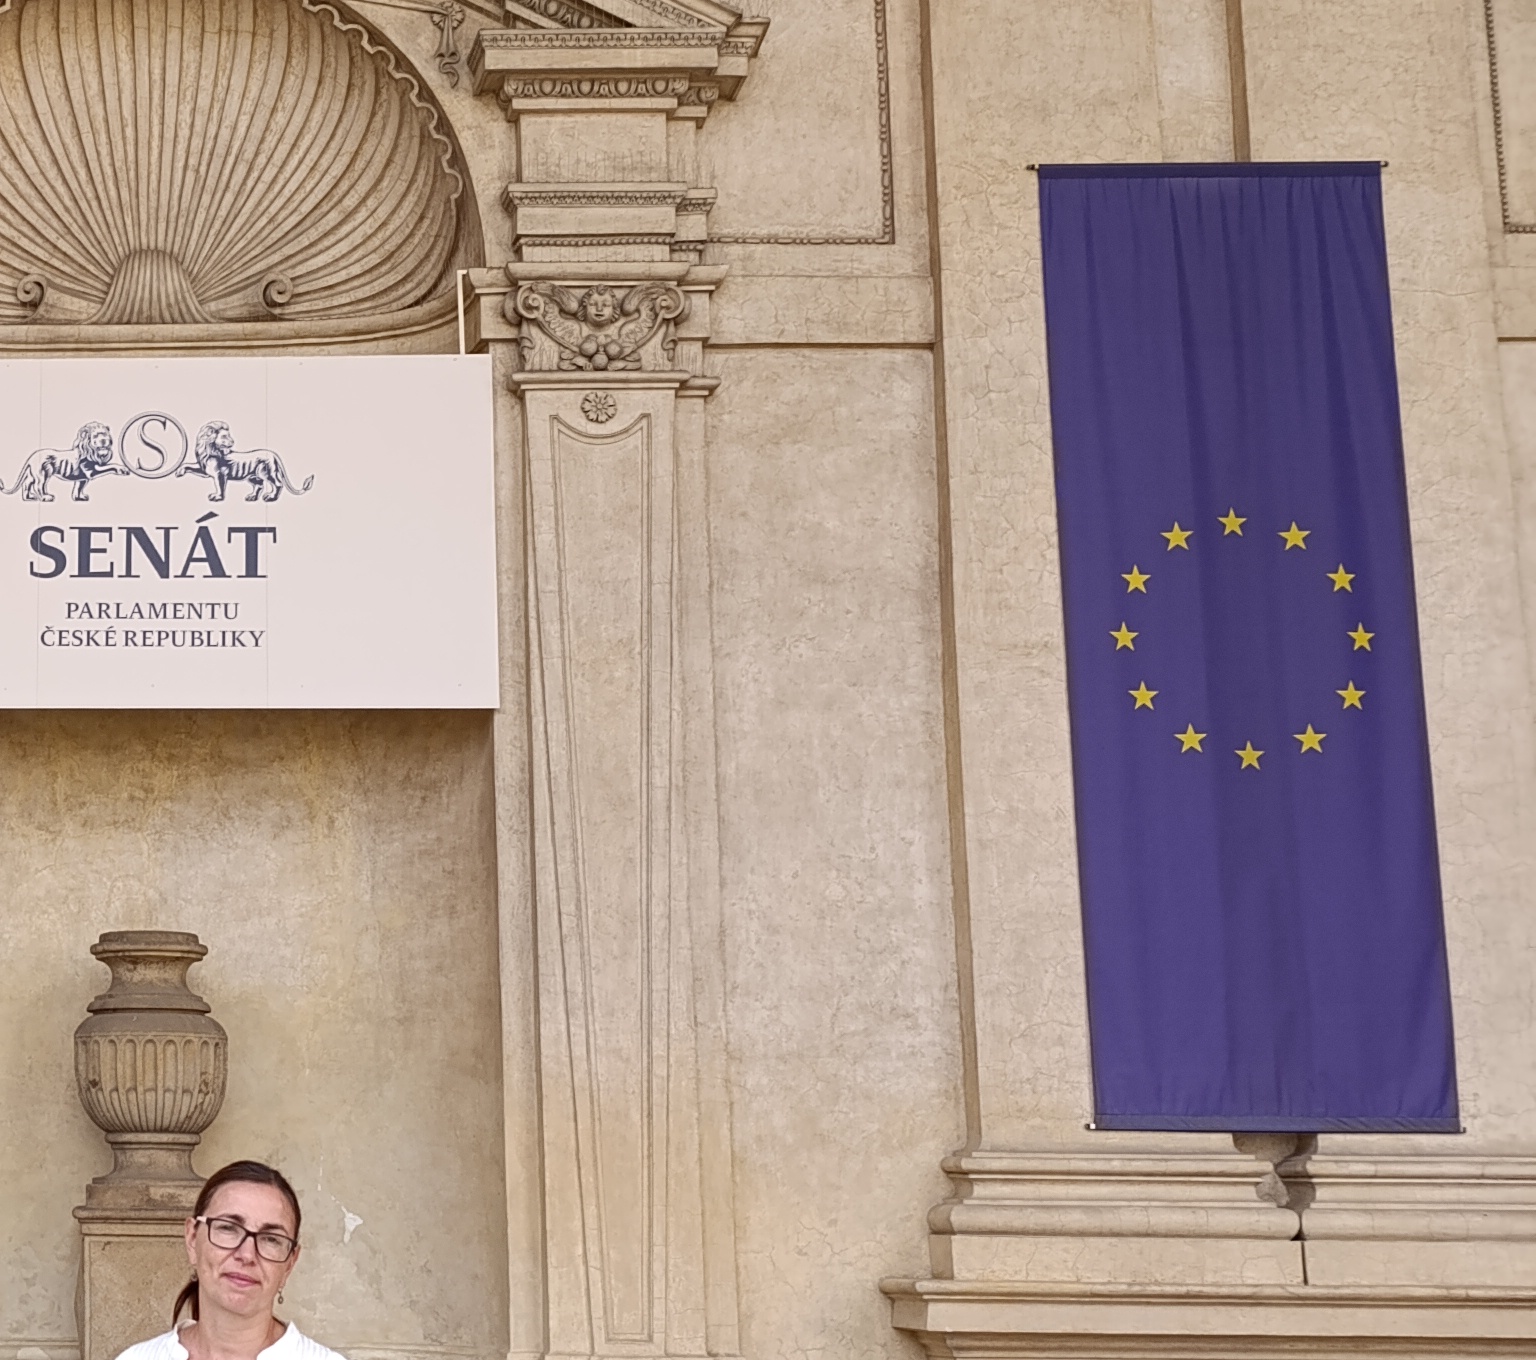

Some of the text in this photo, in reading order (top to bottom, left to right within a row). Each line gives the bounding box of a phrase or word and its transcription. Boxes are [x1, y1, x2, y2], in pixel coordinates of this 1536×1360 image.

[29, 511, 277, 579] SENÁT
[65, 602, 239, 621] PARLAMENTU
[40, 625, 266, 648] ČESKÉ REPUBLIKY
